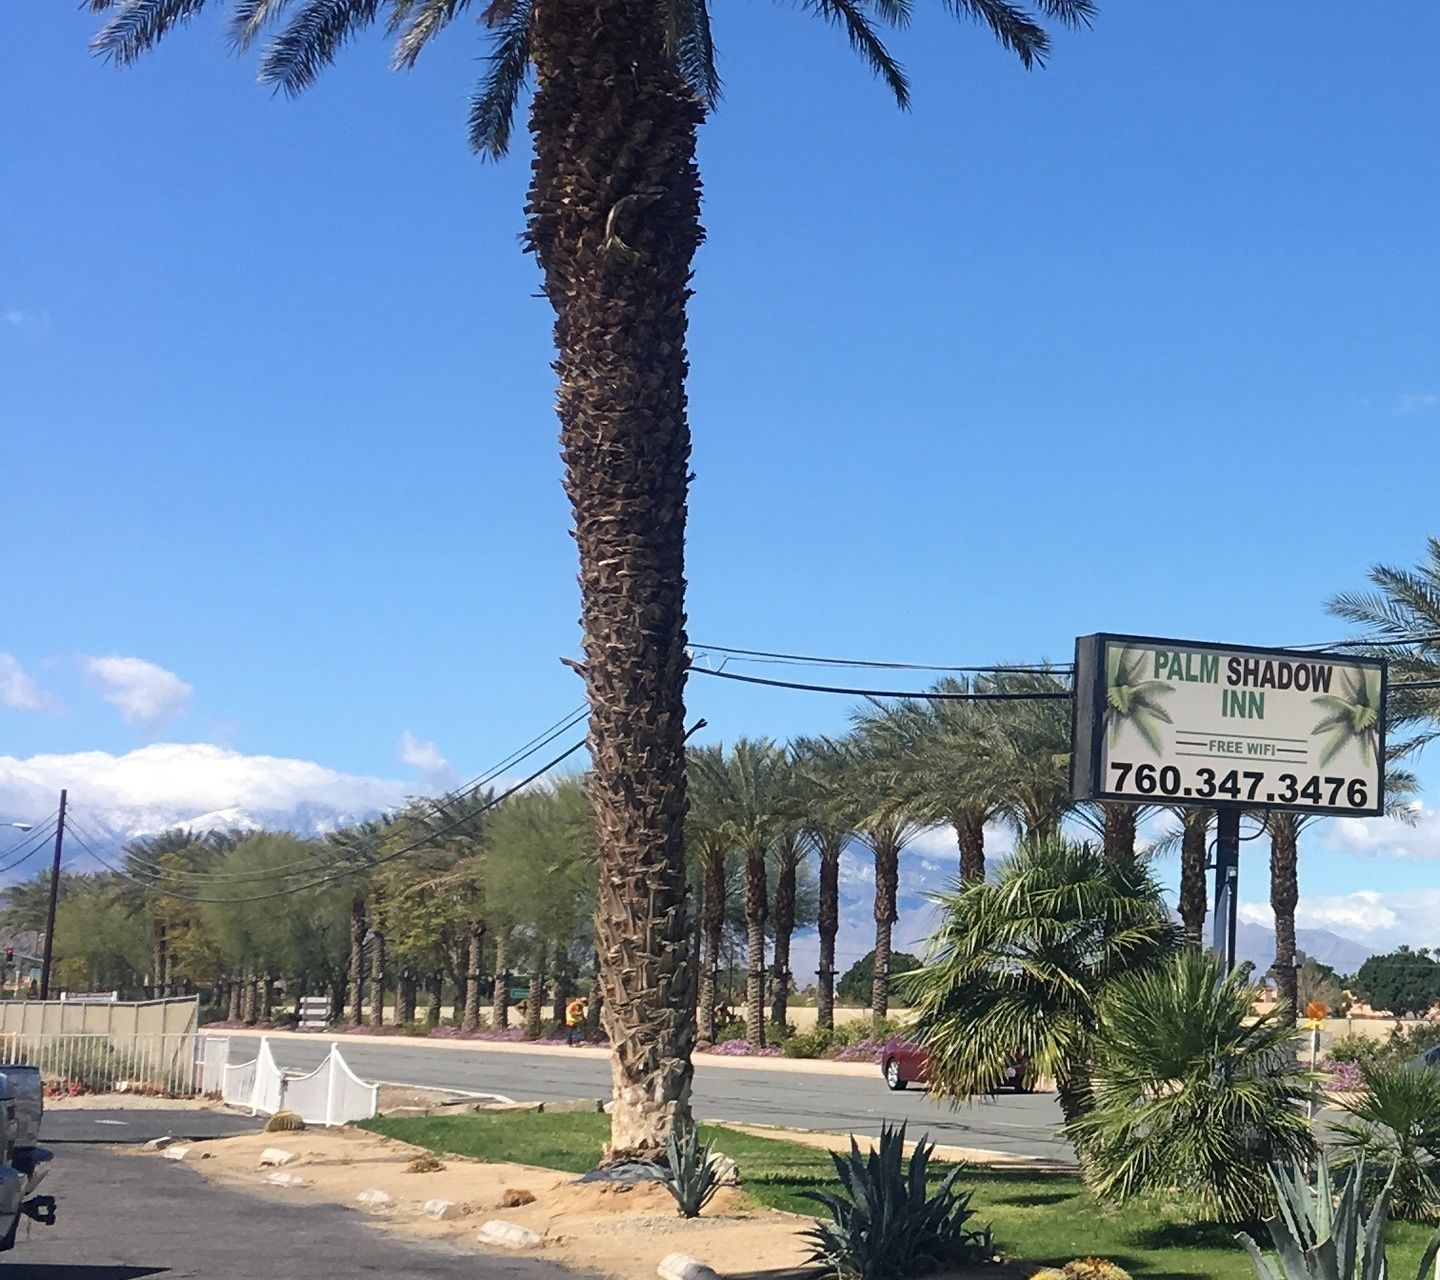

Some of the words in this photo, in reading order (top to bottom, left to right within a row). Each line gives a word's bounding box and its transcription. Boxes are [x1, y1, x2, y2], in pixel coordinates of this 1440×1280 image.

[1154, 650, 1219, 684] PALM
[1227, 656, 1333, 693] SHADOW
[1222, 689, 1265, 720] INN
[1209, 740, 1243, 754] FREE
[1246, 742, 1276, 756] WIFI
[1110, 762, 1368, 808] 760.347.3476
